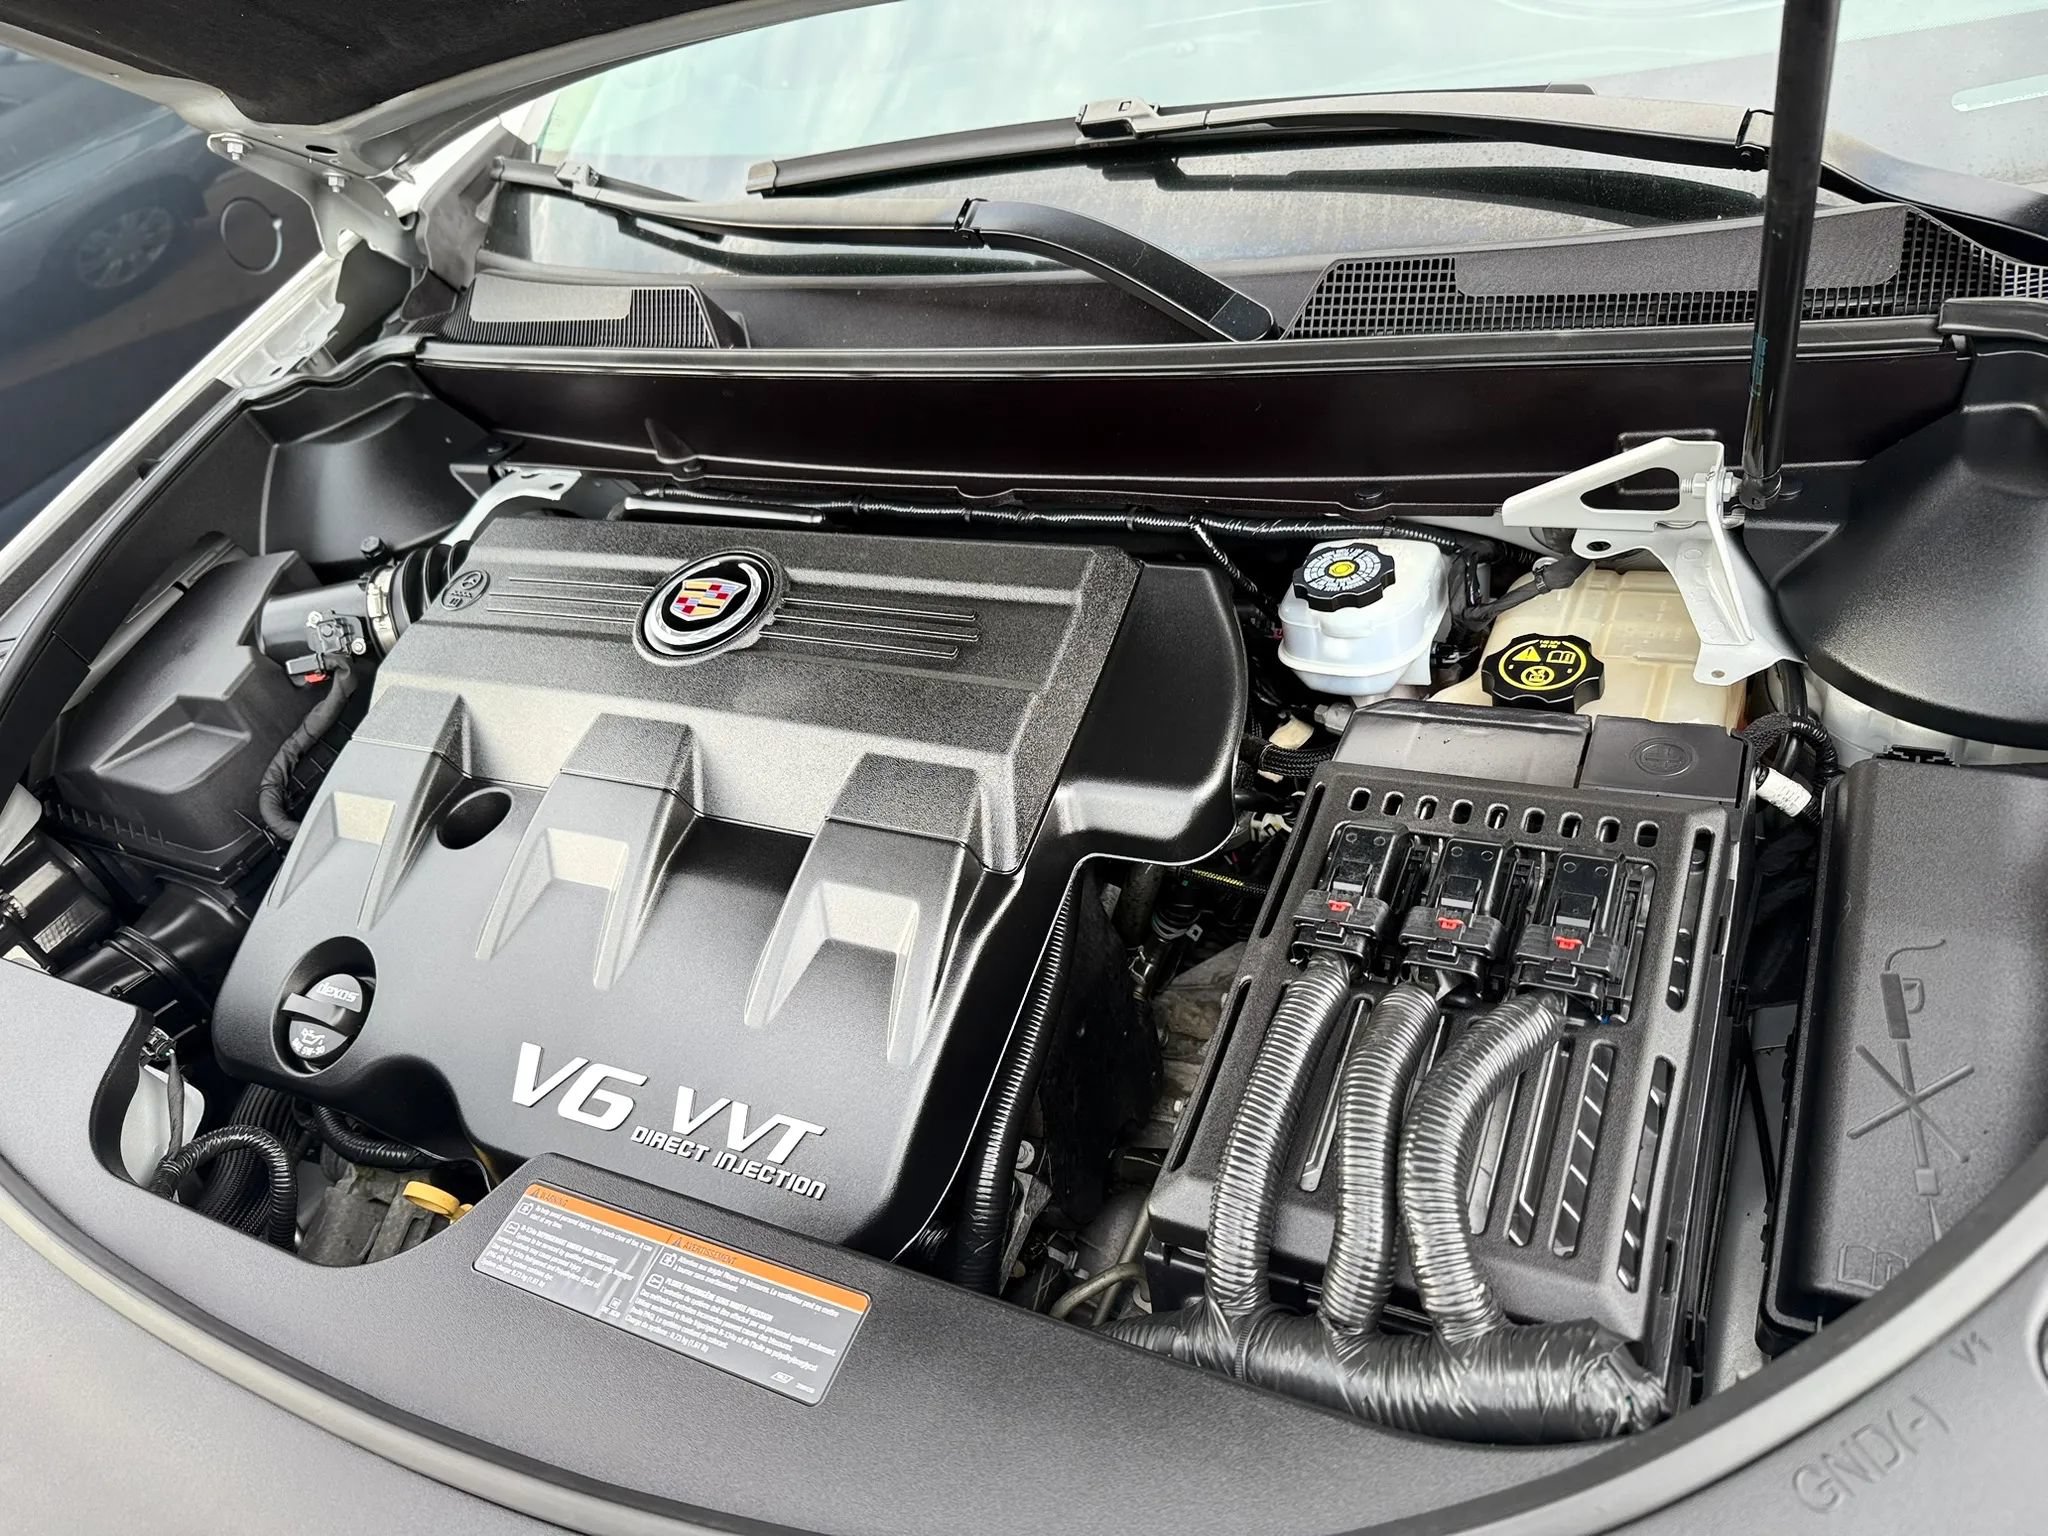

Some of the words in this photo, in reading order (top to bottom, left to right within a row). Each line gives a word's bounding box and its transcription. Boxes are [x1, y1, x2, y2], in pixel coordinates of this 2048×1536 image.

[316, 982, 359, 1002] dexos
[512, 1042, 648, 1130] V6
[673, 1086, 826, 1163] VVT
[631, 1126, 710, 1162] DIRECT
[713, 1150, 826, 1200] INJECTION
[539, 1192, 569, 1207] WARNING
[683, 1241, 737, 1265] AVERTISSEMENT
[1792, 1395, 1950, 1514] GND(-)
